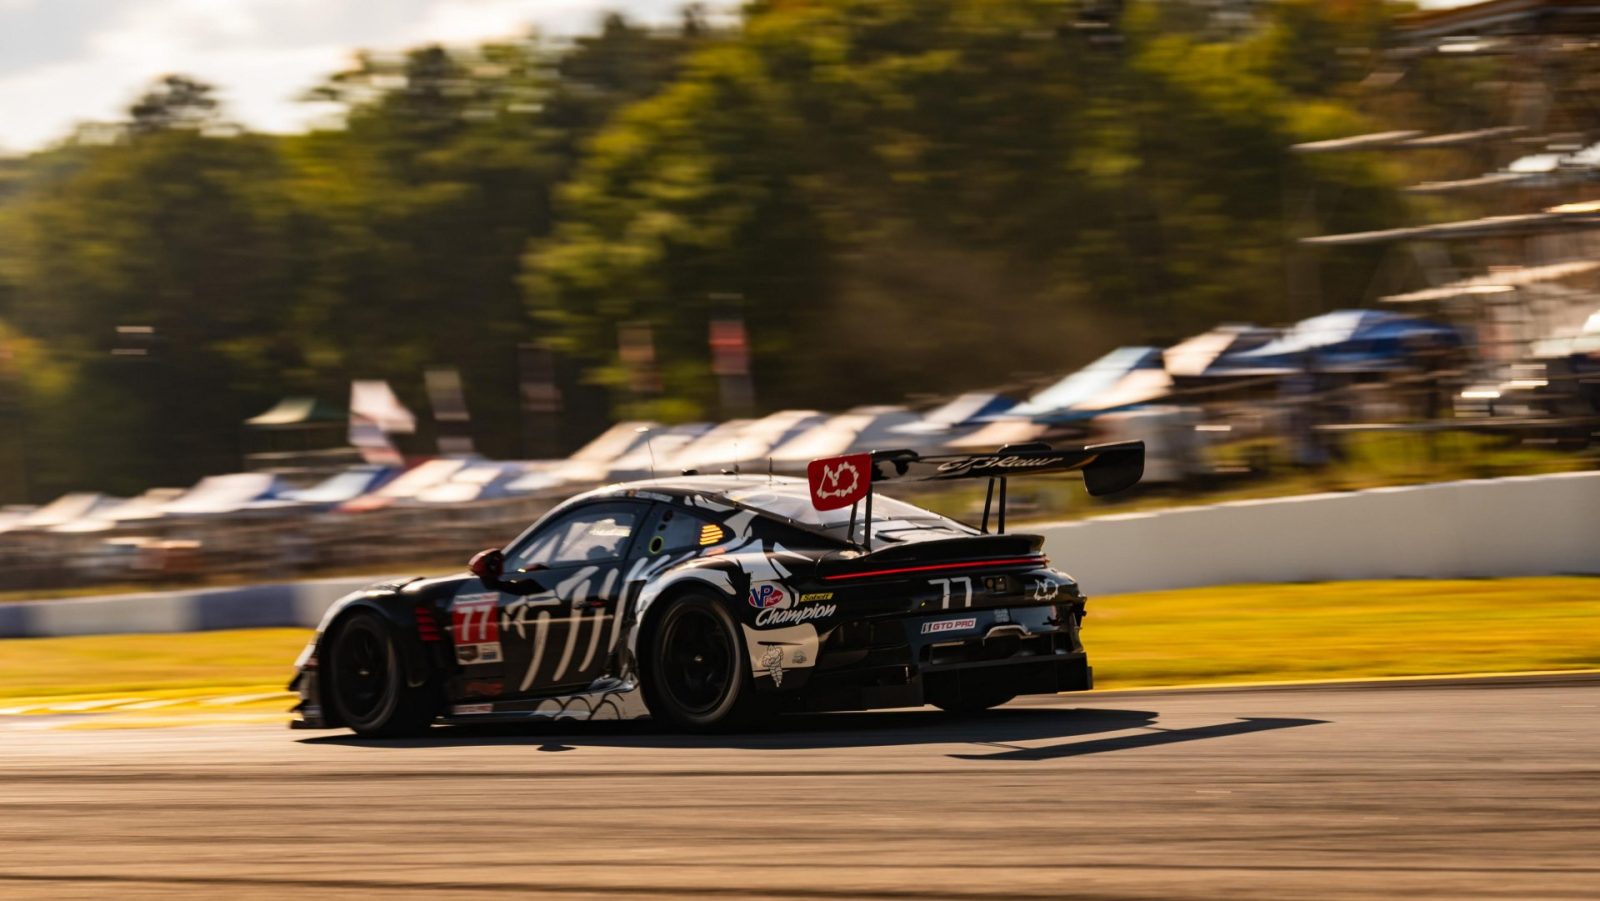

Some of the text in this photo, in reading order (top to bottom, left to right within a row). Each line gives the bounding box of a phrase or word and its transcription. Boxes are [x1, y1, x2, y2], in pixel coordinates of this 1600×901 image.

[751, 585, 774, 608] VP
[928, 576, 973, 610] 77
[457, 605, 493, 641] 77
[755, 602, 837, 627] Champion
[954, 619, 975, 629] PRO
